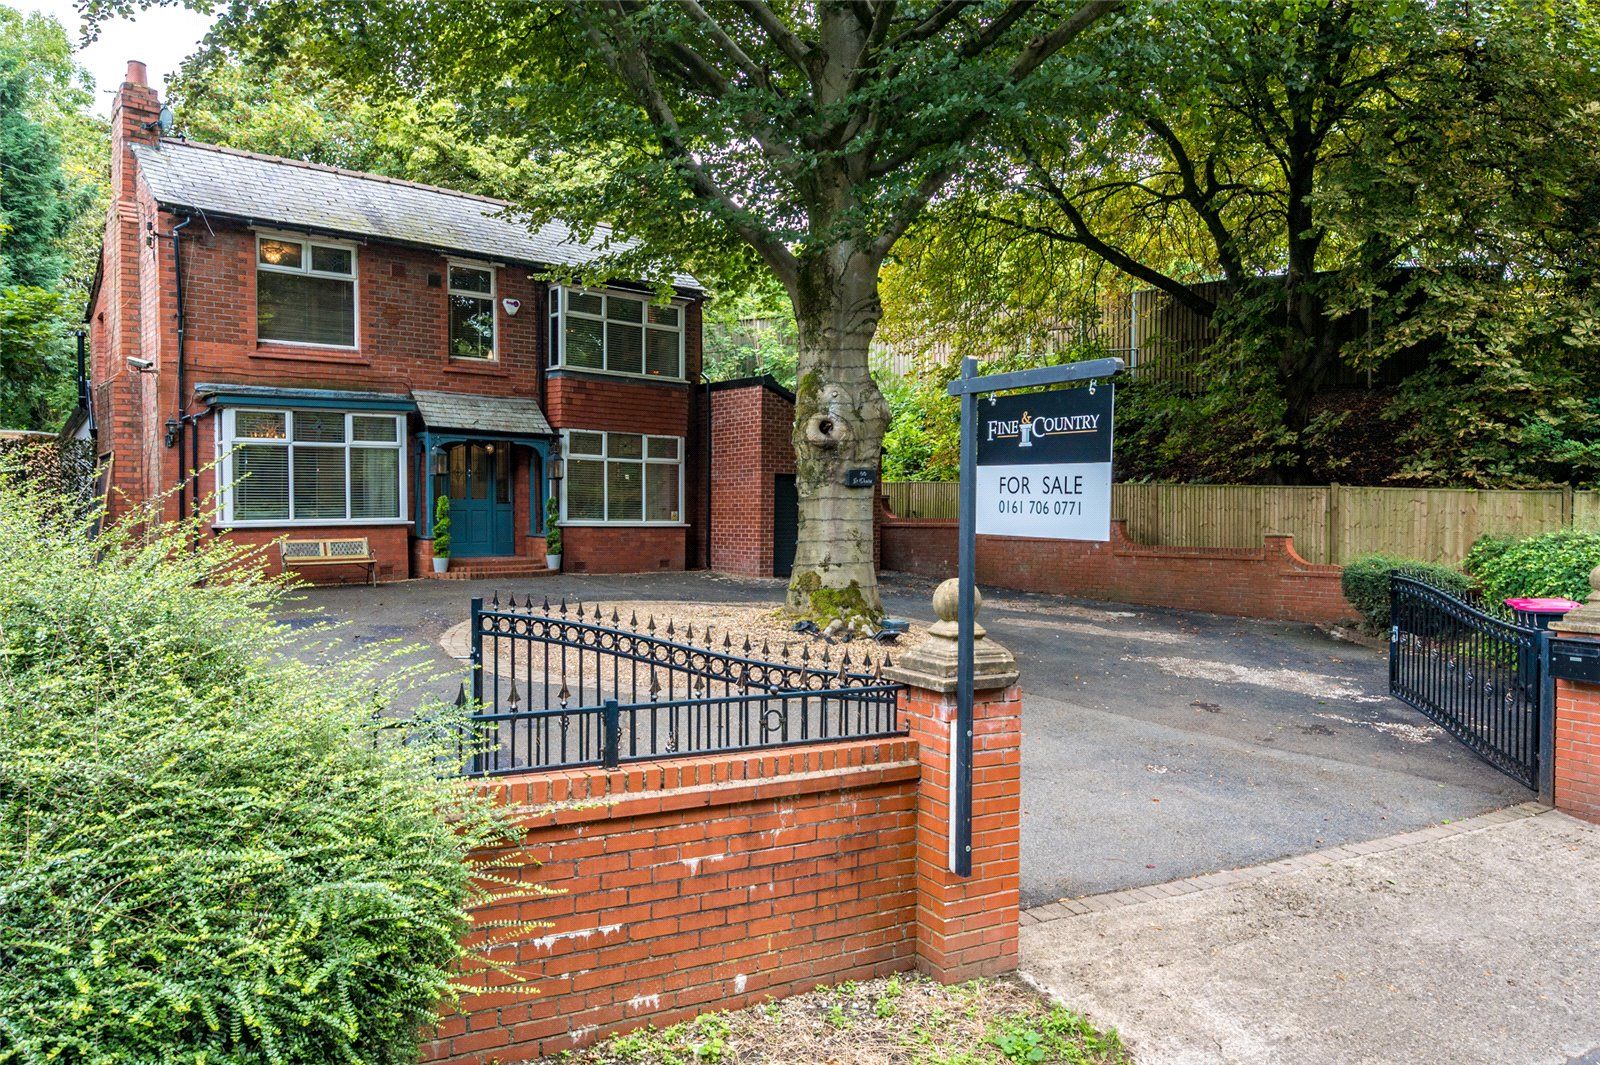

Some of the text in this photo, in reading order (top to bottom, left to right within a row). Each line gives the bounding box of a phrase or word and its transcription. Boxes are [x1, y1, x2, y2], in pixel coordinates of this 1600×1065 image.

[987, 410, 1100, 441] FINE & COUNTRY
[999, 475, 1083, 495] FOR SALE
[998, 500, 1082, 516] 0161 706 0771
